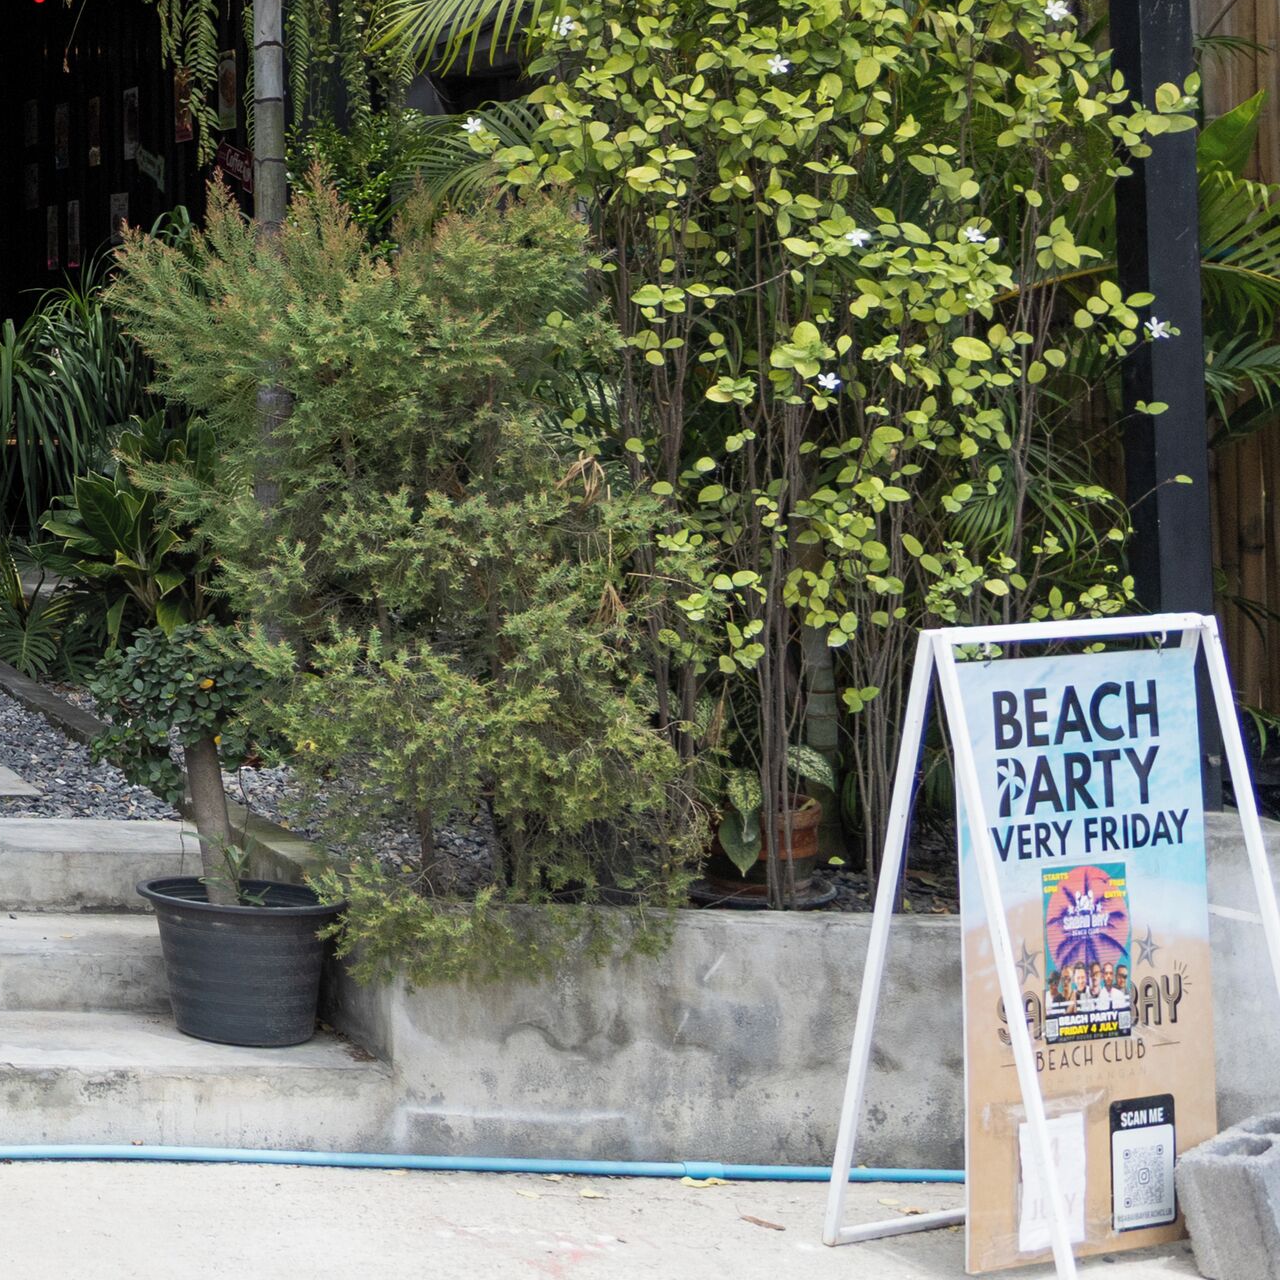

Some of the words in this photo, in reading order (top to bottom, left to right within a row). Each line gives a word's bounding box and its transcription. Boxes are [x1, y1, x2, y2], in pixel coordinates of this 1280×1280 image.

[991, 679, 1160, 751] BEACH
[997, 745, 1159, 817] PARTY
[989, 819, 1073, 862] VERY
[1084, 808, 1189, 855] FRIDAY
[1059, 1014, 1088, 1026] BEACH
[1089, 1011, 1118, 1023] PARTY
[1059, 1025, 1089, 1036] FRIDAY
[1091, 1024, 1097, 1032] 4
[1099, 1021, 1118, 1032] JULY
[1036, 1043, 1093, 1072] BEACH
[1103, 1038, 1146, 1062] CLUB
[1120, 1109, 1148, 1128] SCAN
[1149, 1107, 1164, 1123] ME
